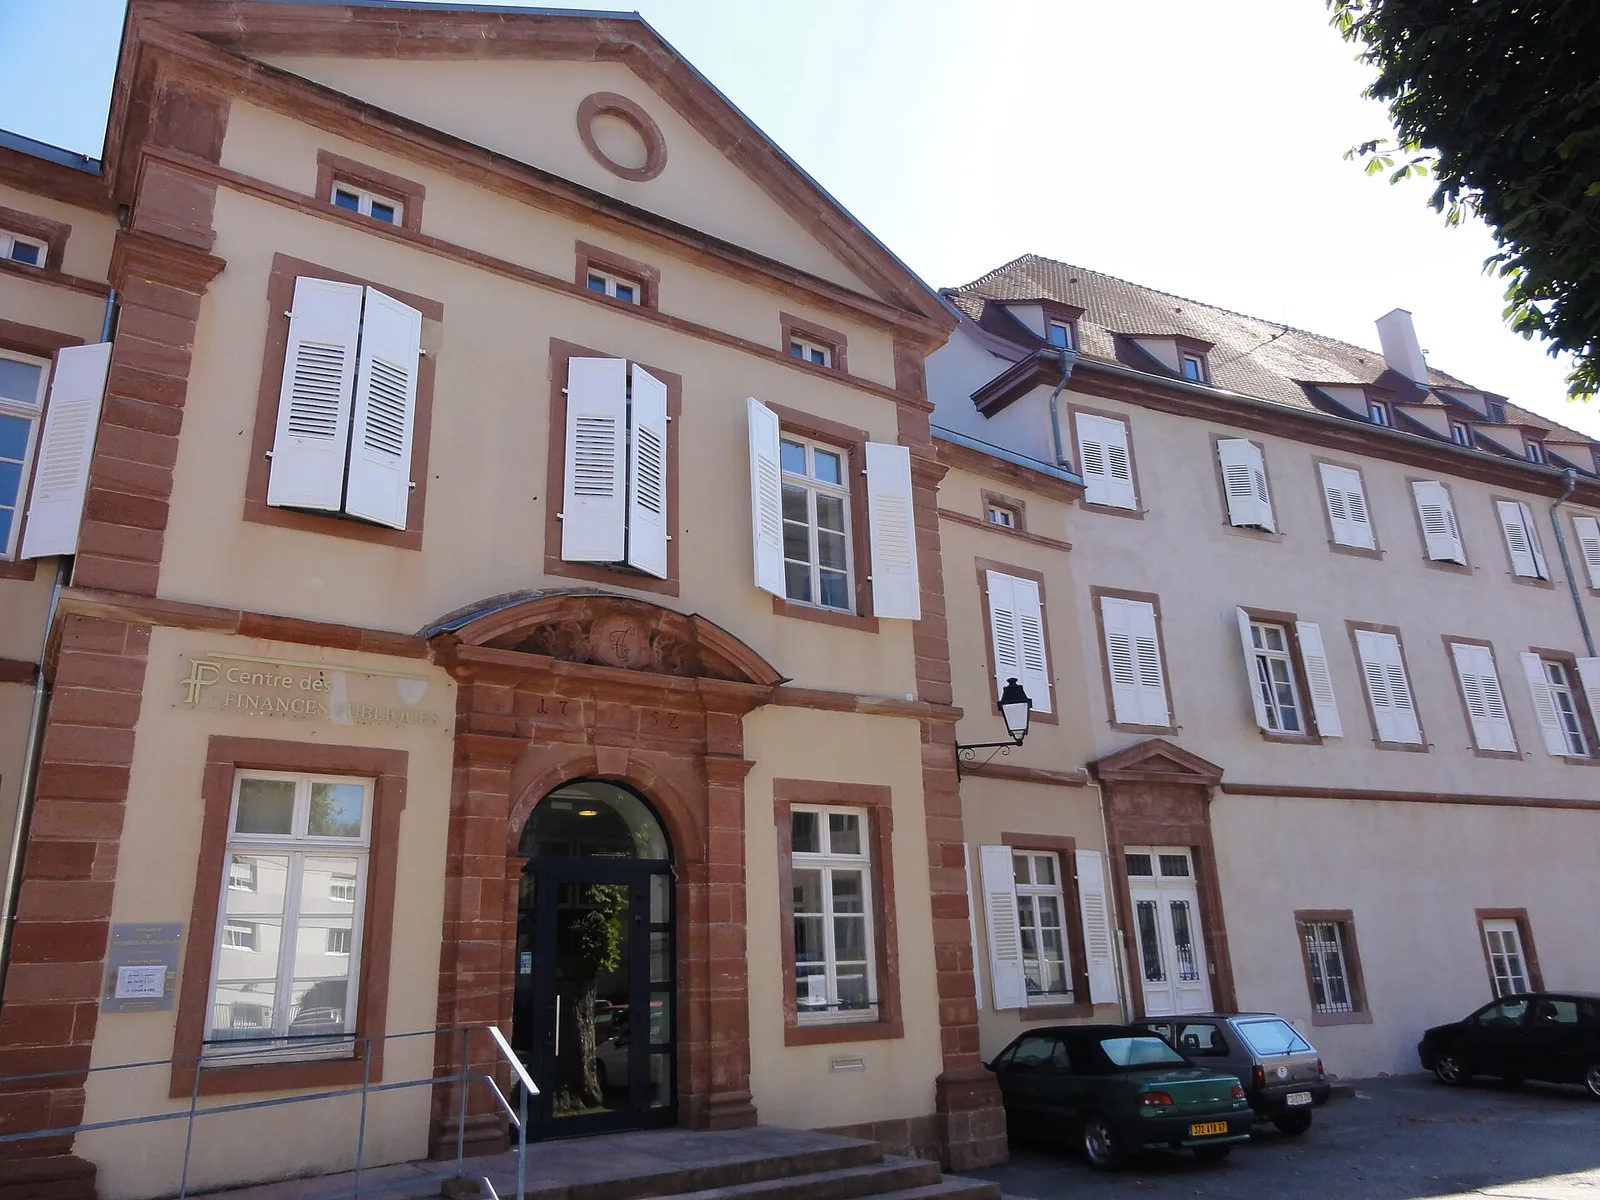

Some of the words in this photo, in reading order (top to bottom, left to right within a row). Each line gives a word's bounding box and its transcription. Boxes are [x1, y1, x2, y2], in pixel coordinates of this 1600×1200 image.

[226, 667, 292, 689] Centre
[299, 674, 331, 693] des
[224, 692, 328, 716] FINANCES
